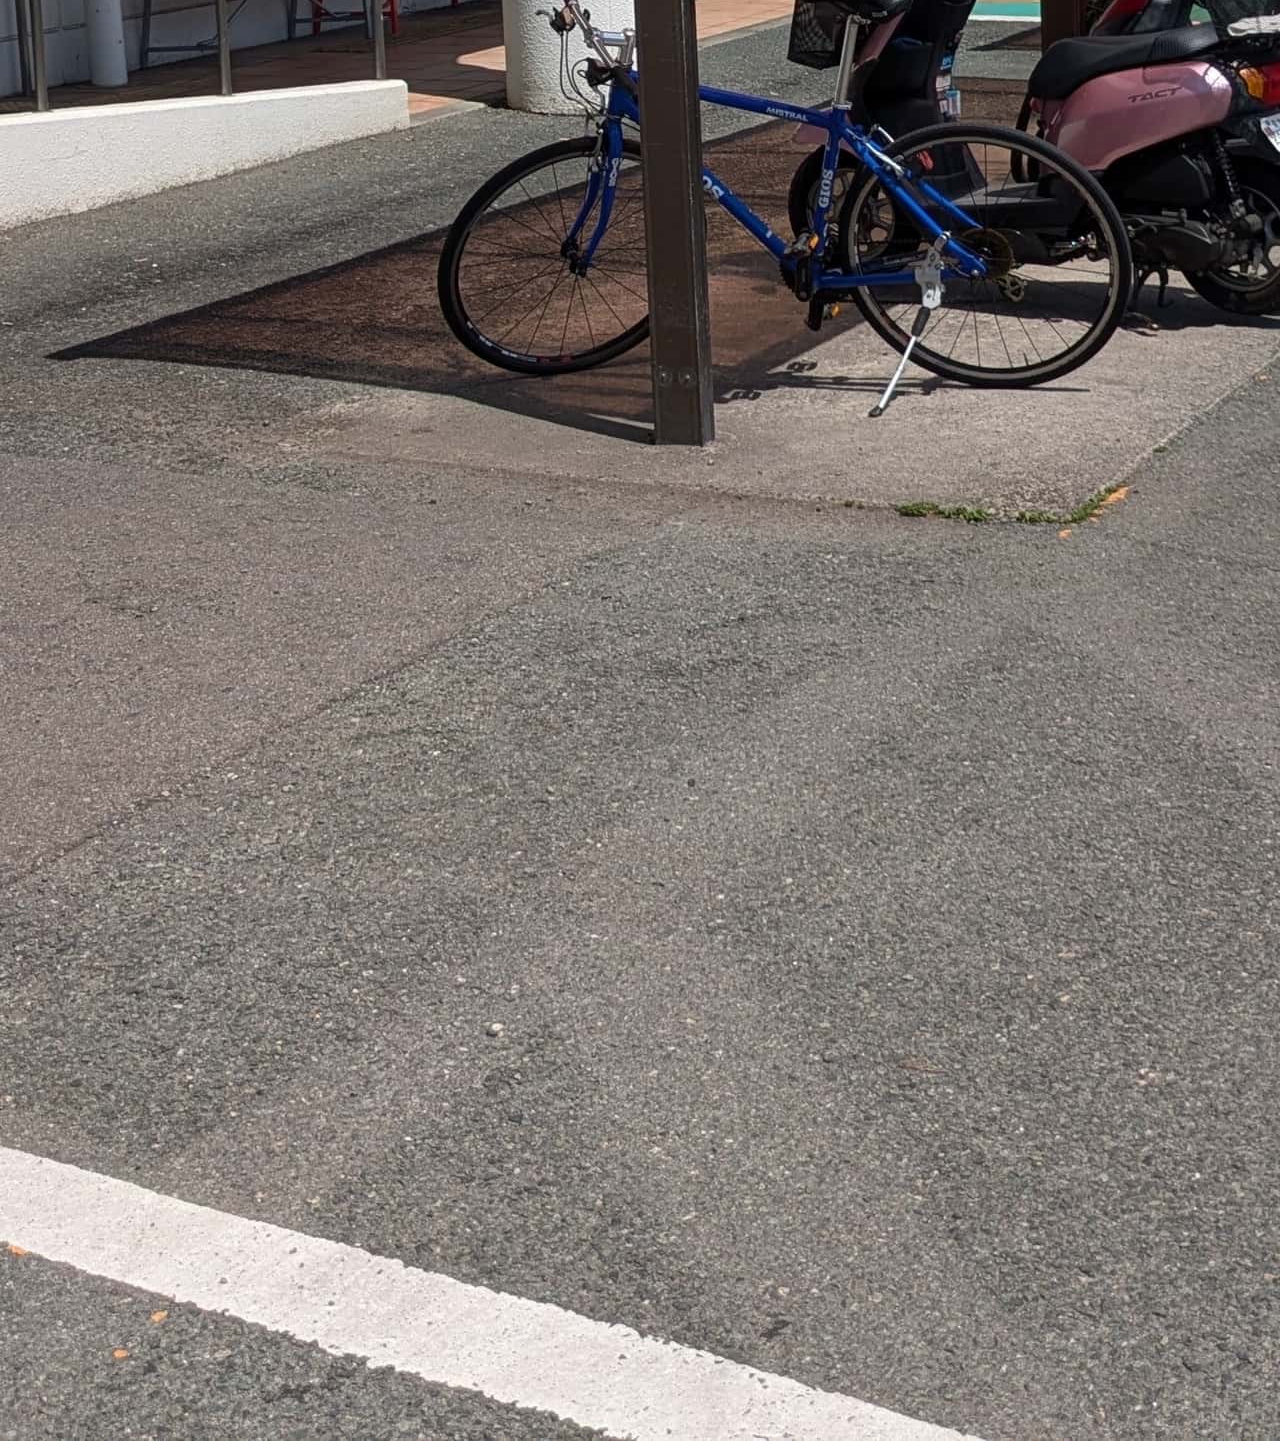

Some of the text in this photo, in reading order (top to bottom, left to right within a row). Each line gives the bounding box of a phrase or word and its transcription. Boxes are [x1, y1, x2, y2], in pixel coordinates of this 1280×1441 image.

[1127, 86, 1182, 103] TACT
[766, 107, 808, 122] MISTRAL
[818, 168, 834, 208] GIOS
